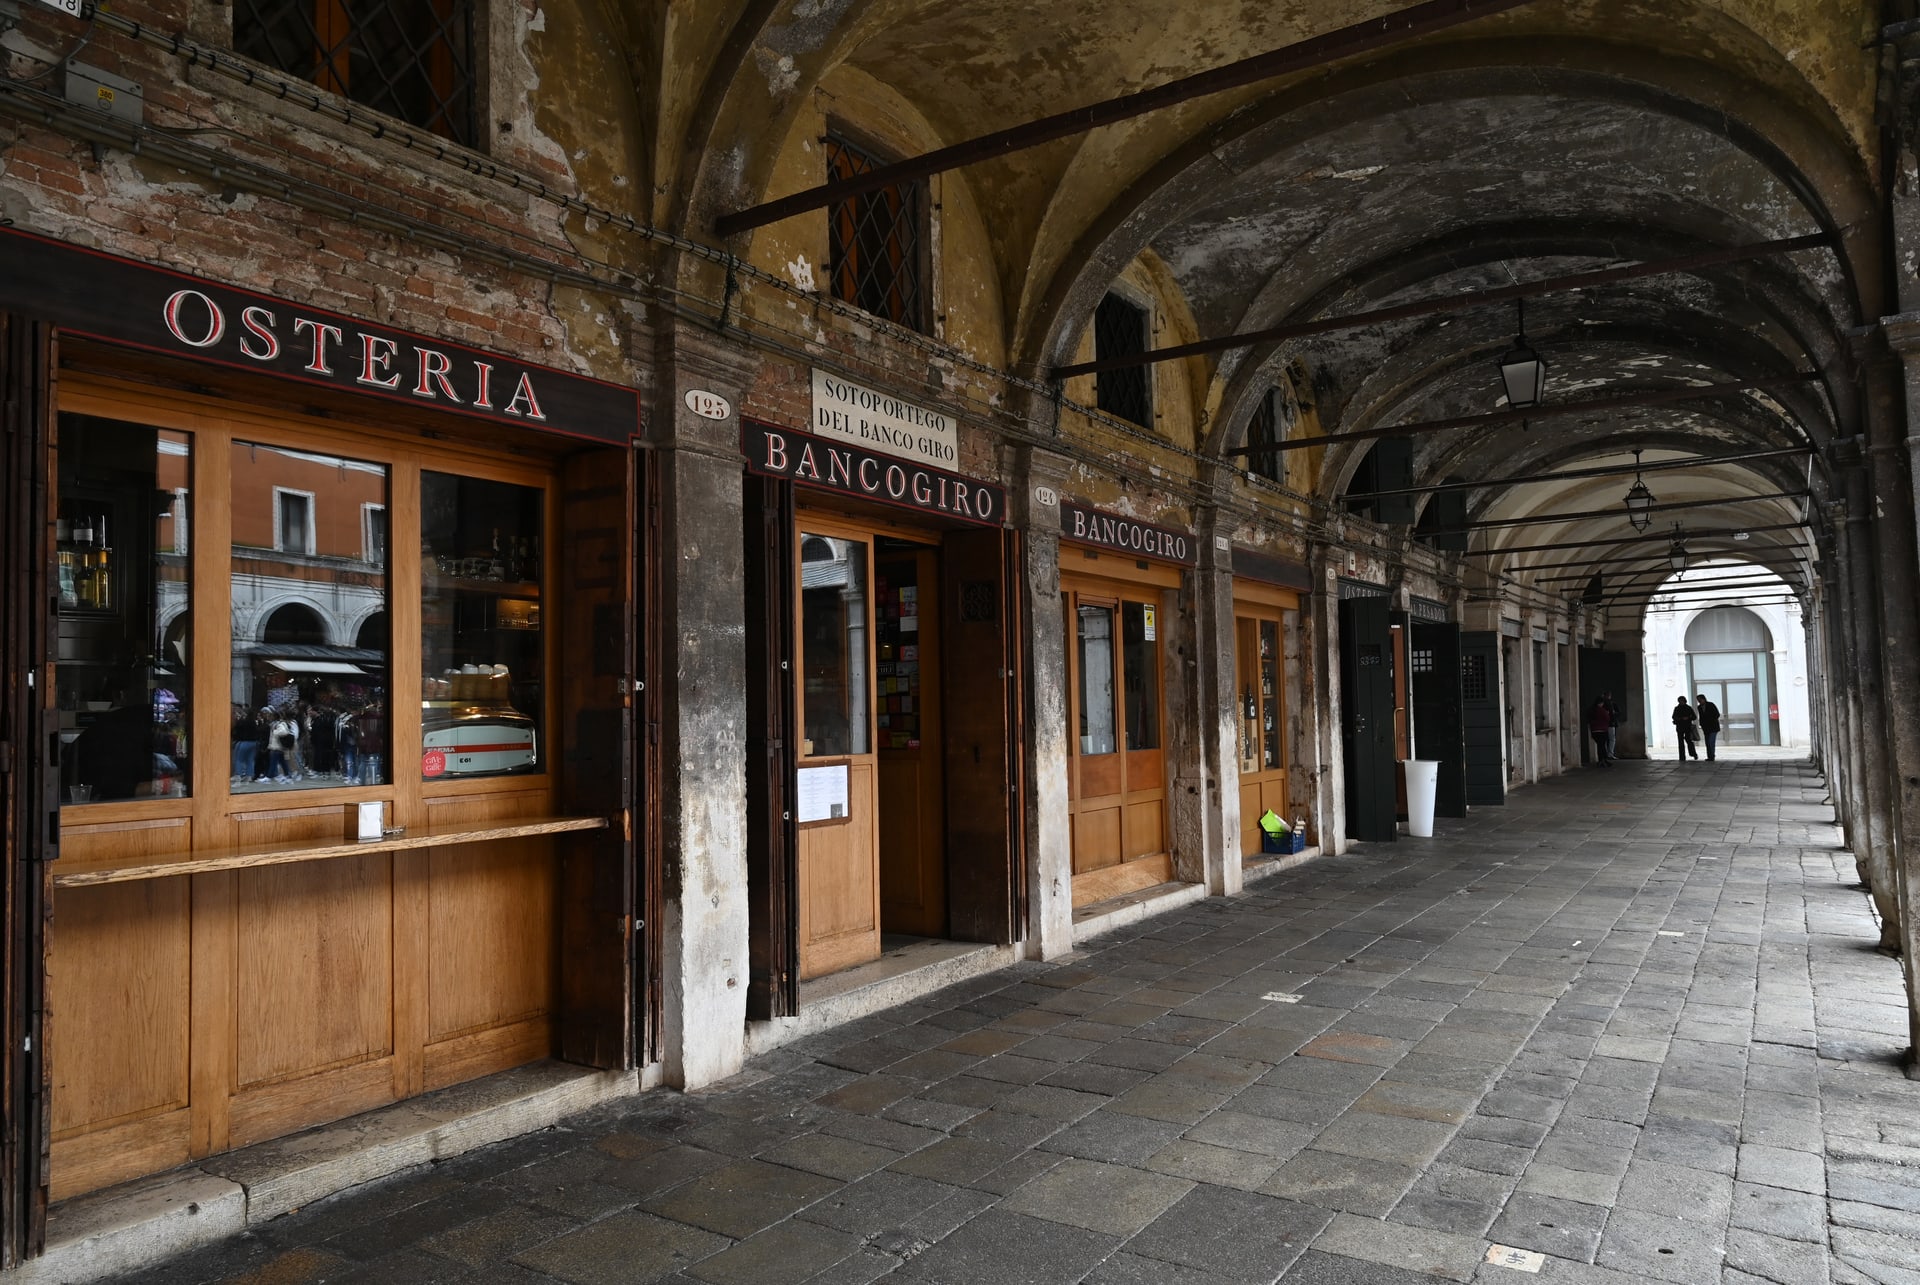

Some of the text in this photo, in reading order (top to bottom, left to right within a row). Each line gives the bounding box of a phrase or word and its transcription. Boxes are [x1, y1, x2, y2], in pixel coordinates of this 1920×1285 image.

[163, 289, 547, 421] OSTERIA
[825, 378, 946, 433] SOTOPORTEGO
[819, 407, 954, 462] DEL BANCO GIRO
[763, 431, 993, 520] BANCOGIRO
[1073, 510, 1186, 560] BANCOGIRO
